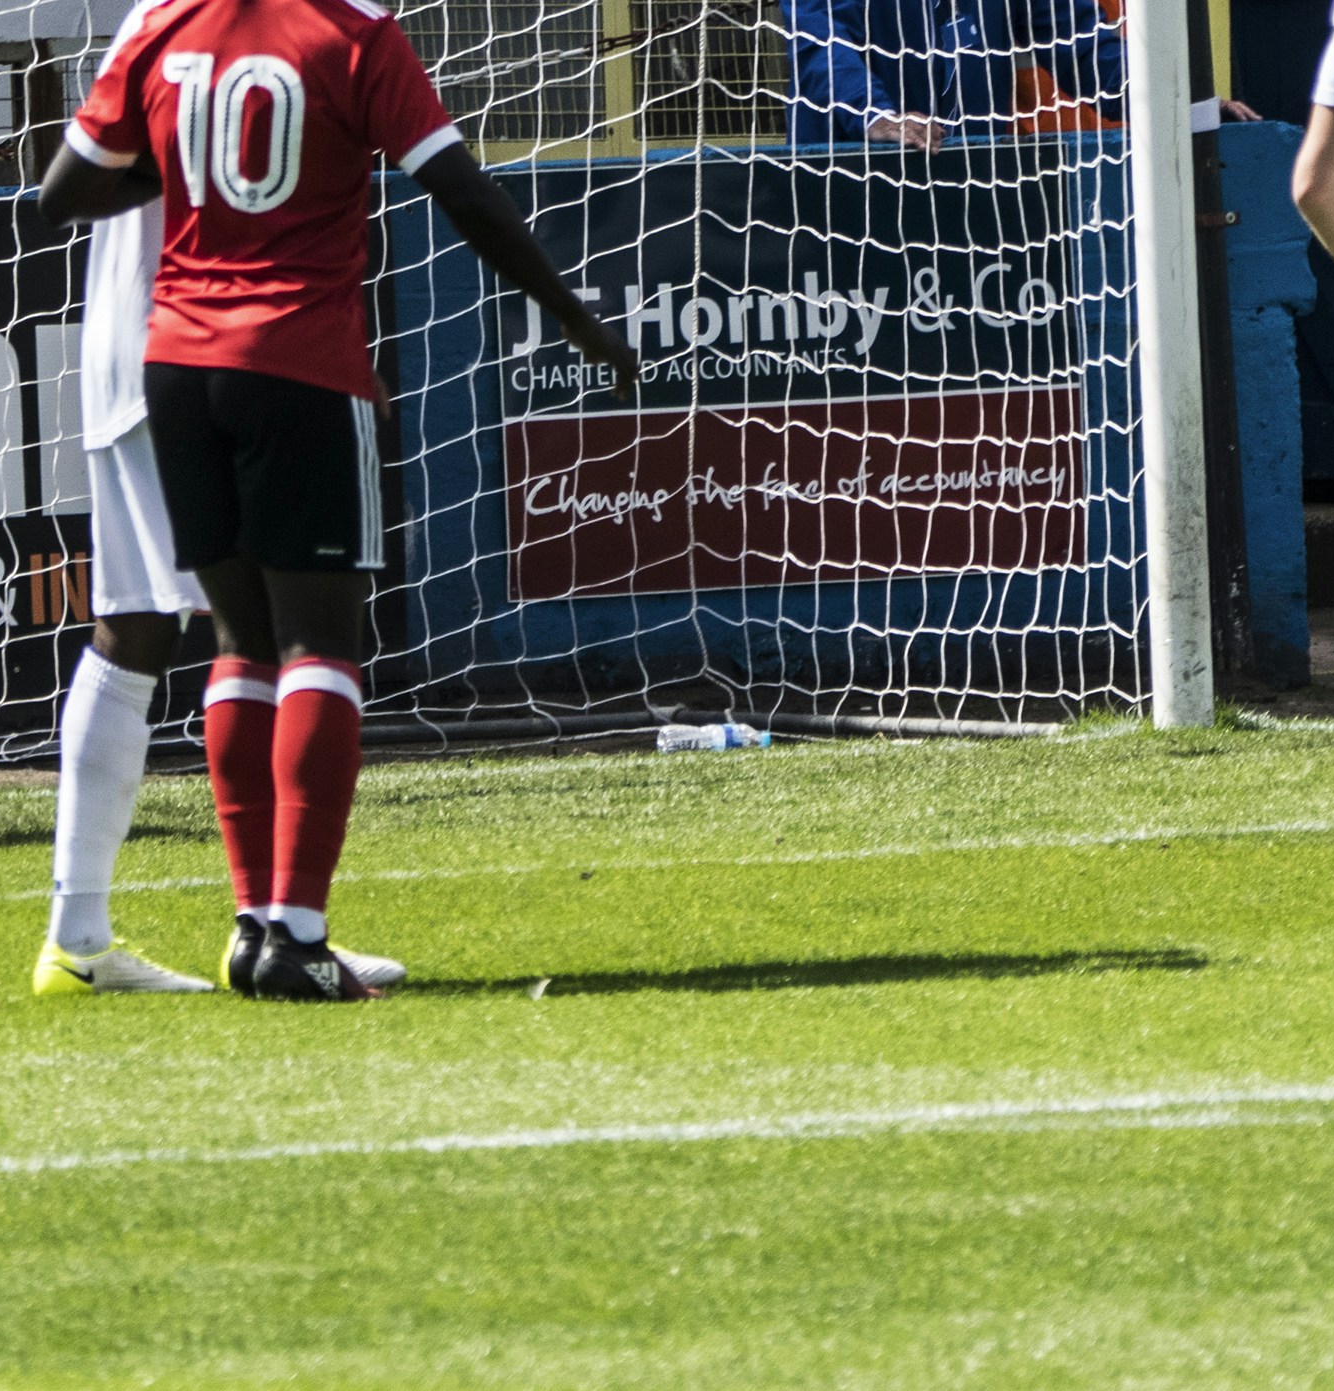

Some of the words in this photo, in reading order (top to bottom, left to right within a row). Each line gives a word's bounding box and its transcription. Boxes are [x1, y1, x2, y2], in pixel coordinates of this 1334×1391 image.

[162, 52, 305, 214] 10
[512, 292, 542, 356] J
[624, 271, 890, 356] Hornby
[910, 267, 956, 333] &
[974, 262, 1056, 328] Co
[666, 348, 847, 383] ACCOUNTANTS
[527, 472, 669, 524] Changing
[685, 466, 744, 510] the
[762, 462, 822, 511] face
[837, 455, 874, 498] of
[879, 459, 1066, 498] accountancy
